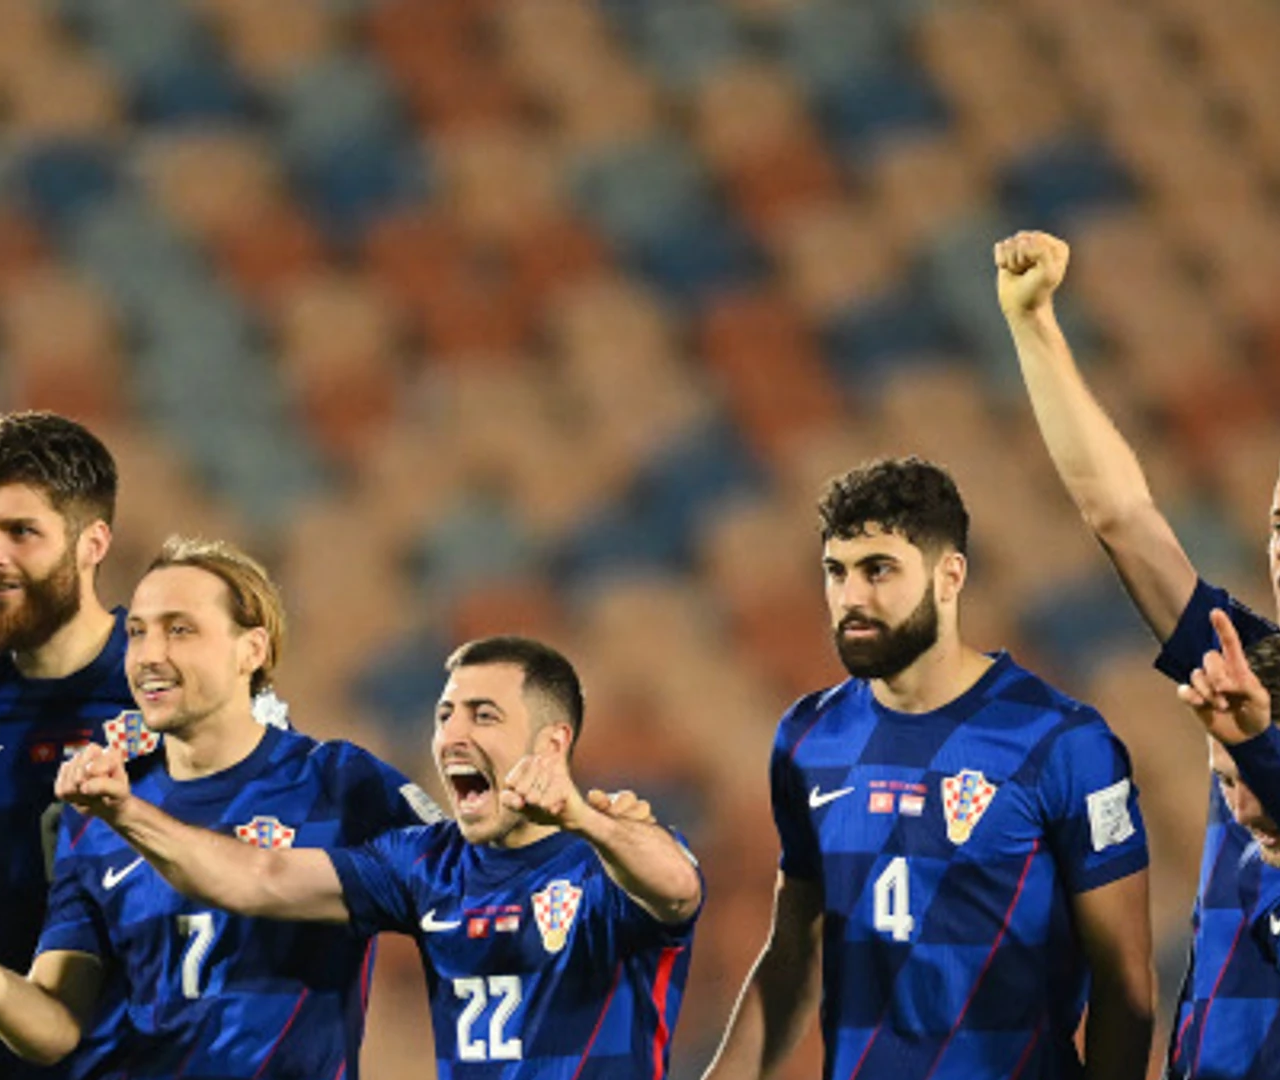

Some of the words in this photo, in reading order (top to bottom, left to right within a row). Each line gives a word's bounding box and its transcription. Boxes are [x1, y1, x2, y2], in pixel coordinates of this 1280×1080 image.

[872, 856, 915, 942] 4
[179, 912, 215, 999] 7
[452, 974, 523, 1061] 22
